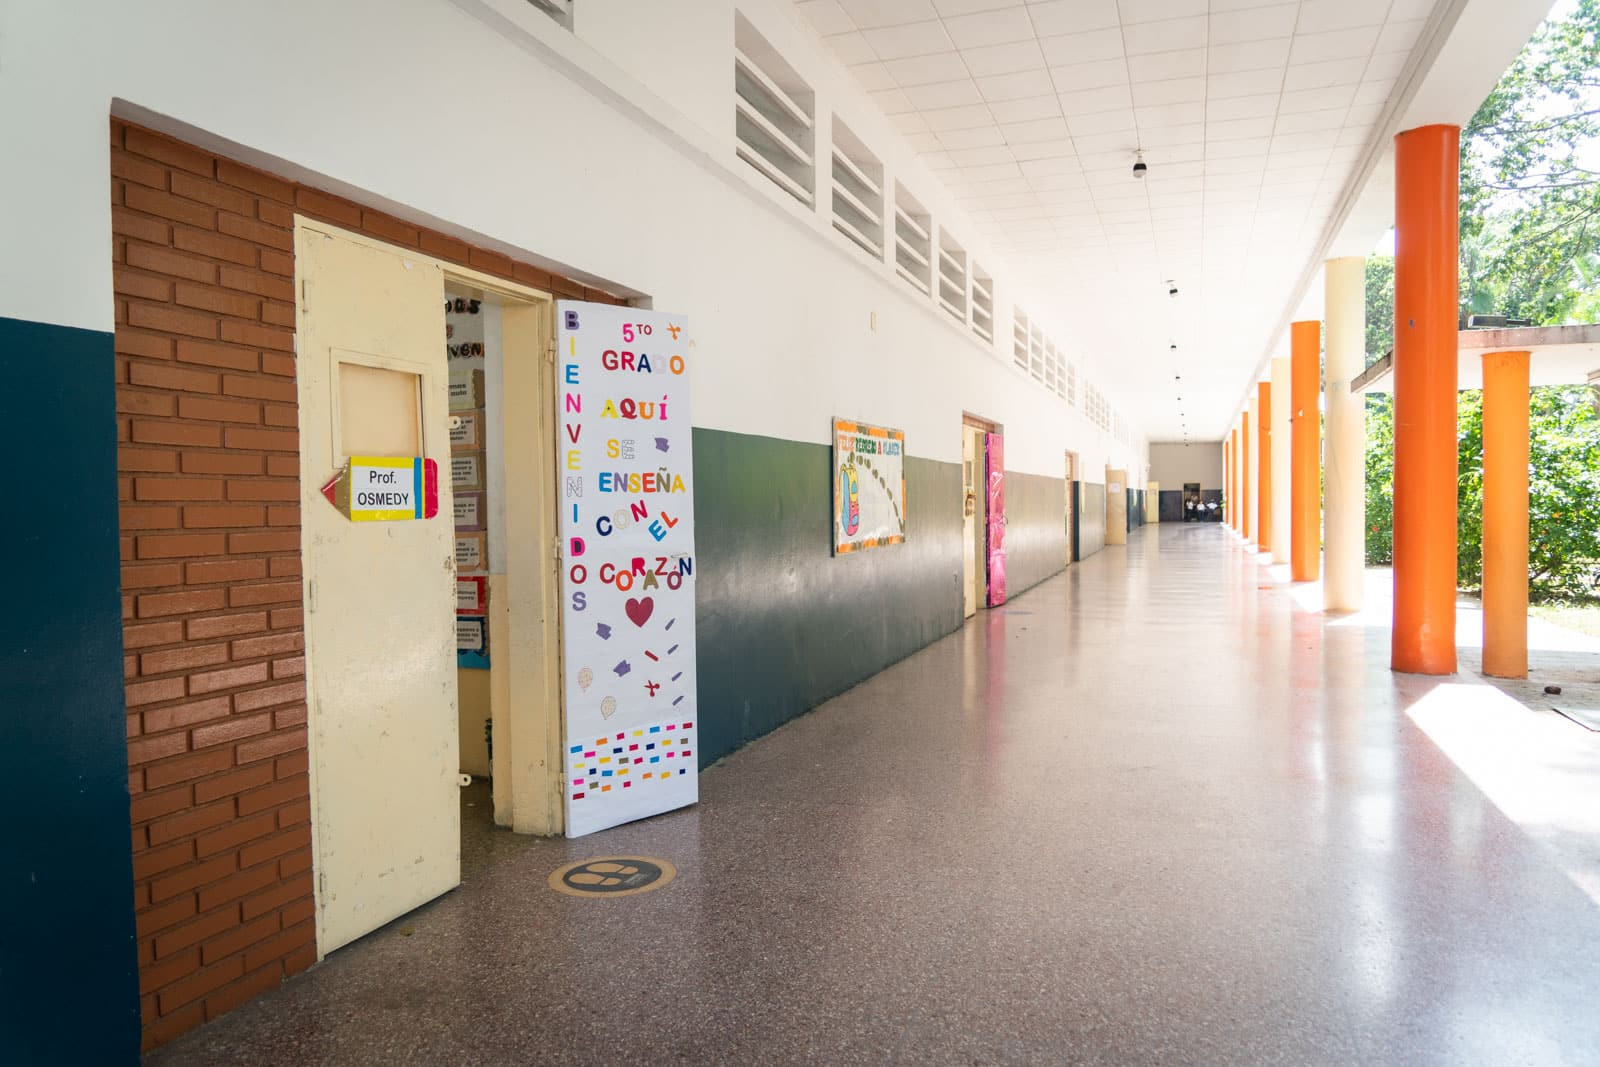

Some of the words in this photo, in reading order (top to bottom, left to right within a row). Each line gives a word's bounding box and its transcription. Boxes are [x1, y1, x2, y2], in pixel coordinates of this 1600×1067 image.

[602, 349, 685, 376] GRADO
[600, 394, 668, 421] AQUÍ
[564, 310, 587, 611] BIENVENIDOS
[607, 439, 635, 460] SE
[369, 470, 397, 484] Prof.
[599, 467, 686, 494] ENSEÑA
[358, 492, 409, 506] OSMEDY
[596, 499, 648, 537] CON
[648, 511, 678, 542] EL
[599, 556, 693, 591] CORAZÓN
